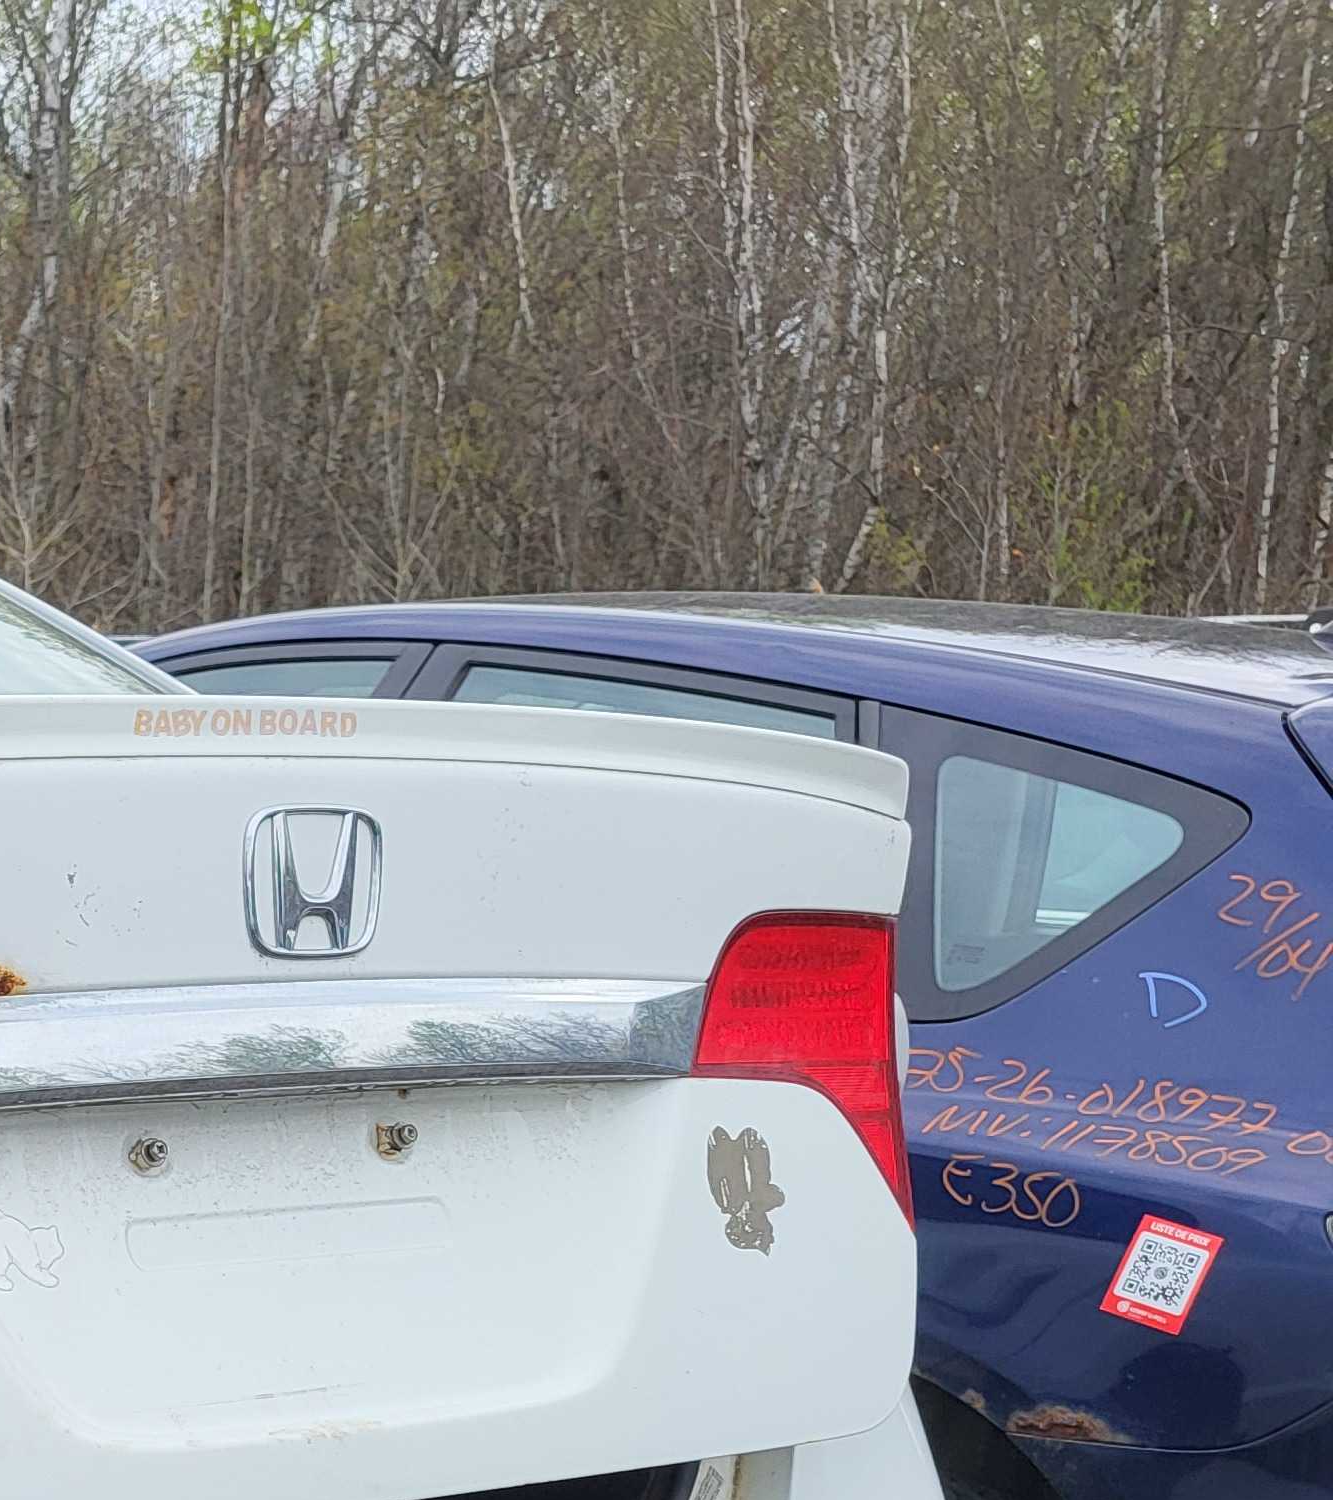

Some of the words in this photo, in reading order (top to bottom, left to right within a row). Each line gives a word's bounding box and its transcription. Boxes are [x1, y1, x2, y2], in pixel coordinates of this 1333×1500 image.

[133, 708, 208, 738] BABY
[210, 708, 253, 737] ON
[258, 708, 358, 738] BOARD
[1138, 970, 1209, 1029] D
